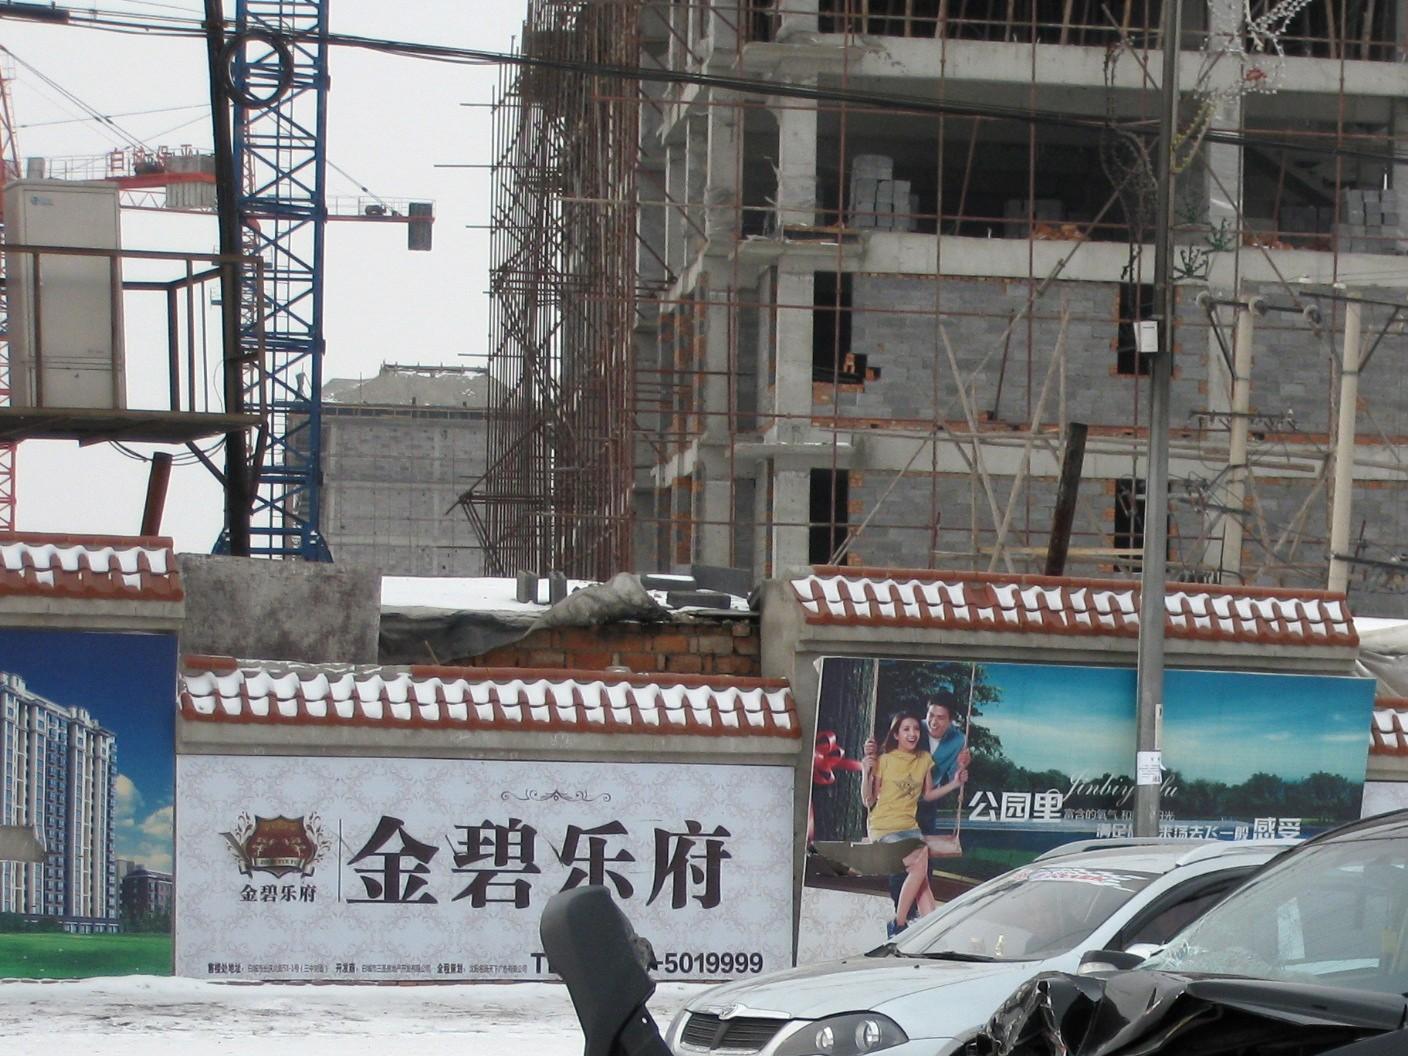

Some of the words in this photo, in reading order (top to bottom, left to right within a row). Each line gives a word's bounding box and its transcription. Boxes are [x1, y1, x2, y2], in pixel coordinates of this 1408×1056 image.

[968, 791, 1063, 823] 公园里
[1253, 817, 1302, 841] 感受
[346, 815, 732, 909] 金碧乐府
[239, 884, 317, 903] 金碧乐府
